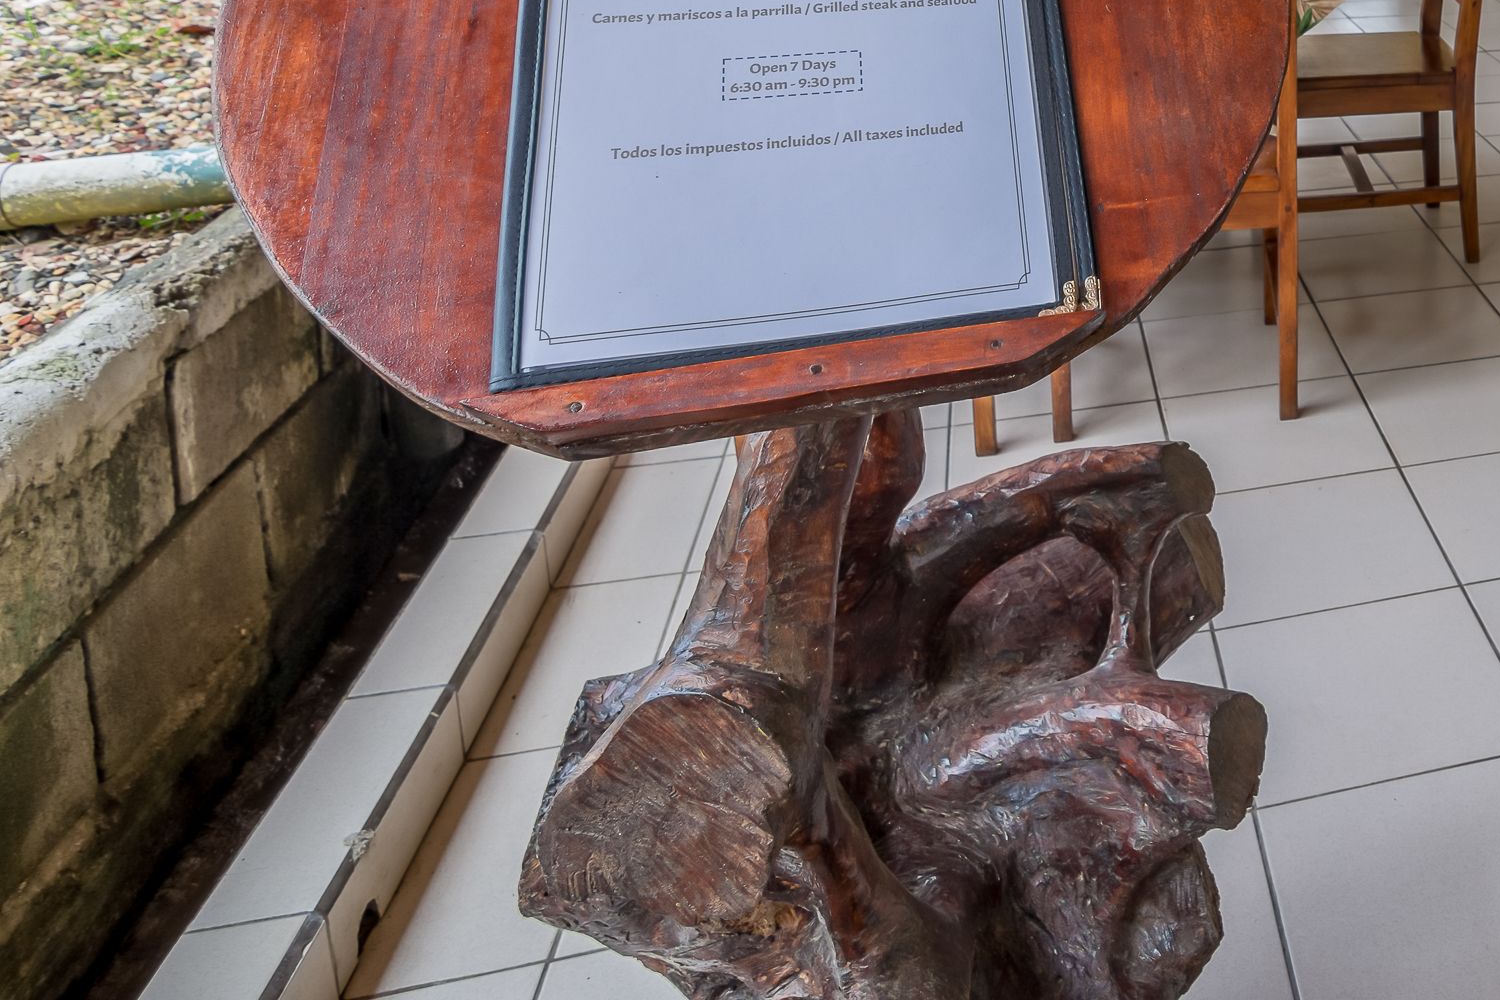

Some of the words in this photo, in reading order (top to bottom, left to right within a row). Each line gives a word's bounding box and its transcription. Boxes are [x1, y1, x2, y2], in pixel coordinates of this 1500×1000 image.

[592, 12, 643, 24] Carnes
[646, 13, 655, 25] y
[658, 9, 722, 22] mariscos
[724, 8, 733, 18] a
[736, 7, 749, 18] la
[751, 3, 802, 20] parrilla
[805, 3, 810, 16] /
[813, 0, 859, 14] Grilled
[749, 63, 788, 76] Open
[790, 61, 799, 72] 7
[802, 59, 837, 72] Days
[730, 81, 762, 93] 6:30
[765, 81, 788, 91] am
[798, 76, 830, 89] 9:30
[832, 76, 856, 89] pm
[610, 146, 657, 160] Todos
[660, 145, 682, 157] los
[685, 140, 764, 156] impuestos
[766, 134, 832, 150] incluidos
[842, 130, 863, 143] All
[866, 129, 903, 141] taxes
[905, 121, 964, 138] included
